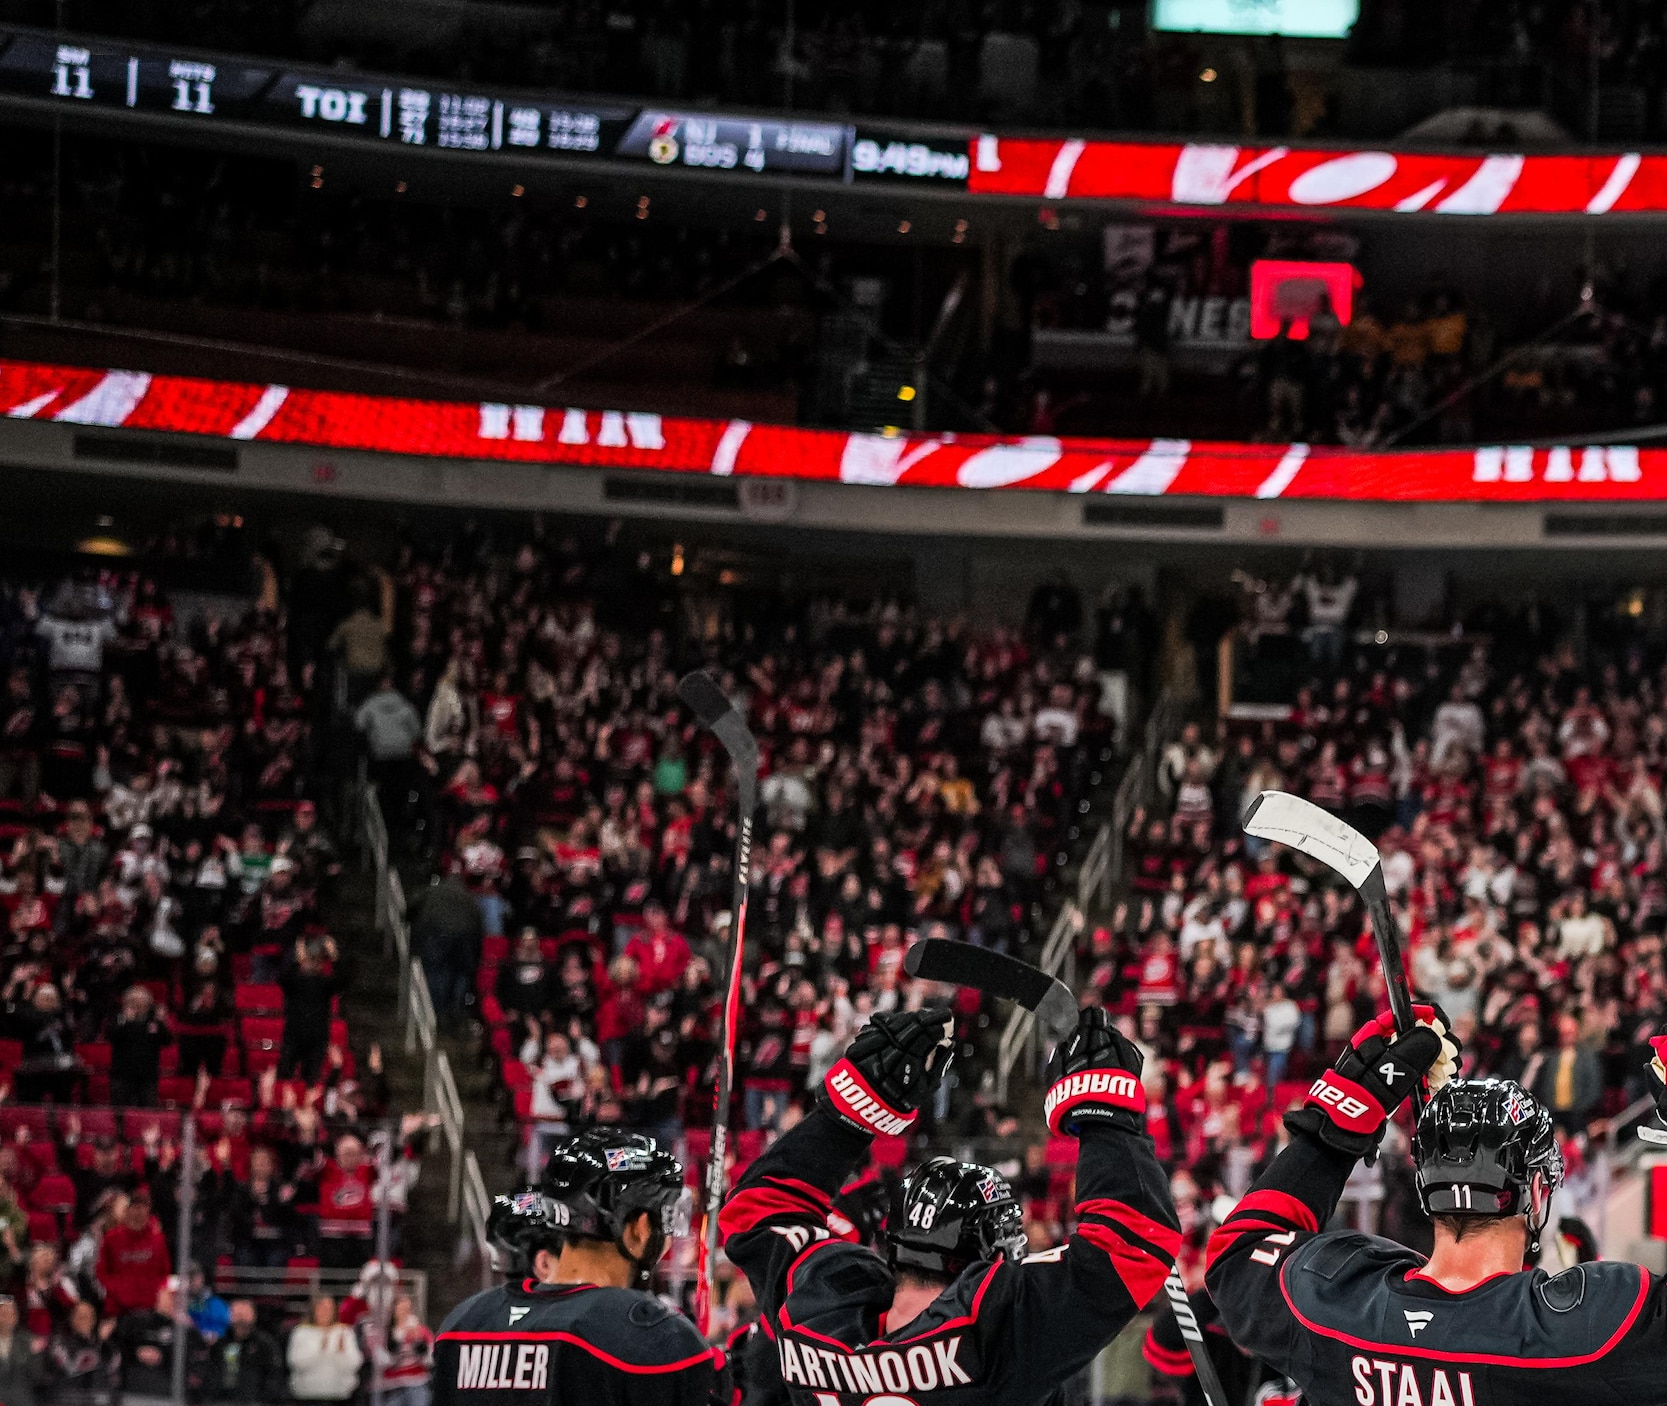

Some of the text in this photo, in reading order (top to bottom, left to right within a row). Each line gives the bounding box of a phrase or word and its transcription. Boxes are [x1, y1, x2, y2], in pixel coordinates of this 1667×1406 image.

[51, 64, 94, 98] 11
[171, 79, 214, 113] 11
[295, 84, 368, 124] TOI
[1450, 1183, 1472, 1209] 11
[908, 1200, 935, 1228] 48
[457, 1344, 552, 1389] MILLER
[778, 1335, 974, 1394] ARTINOOK
